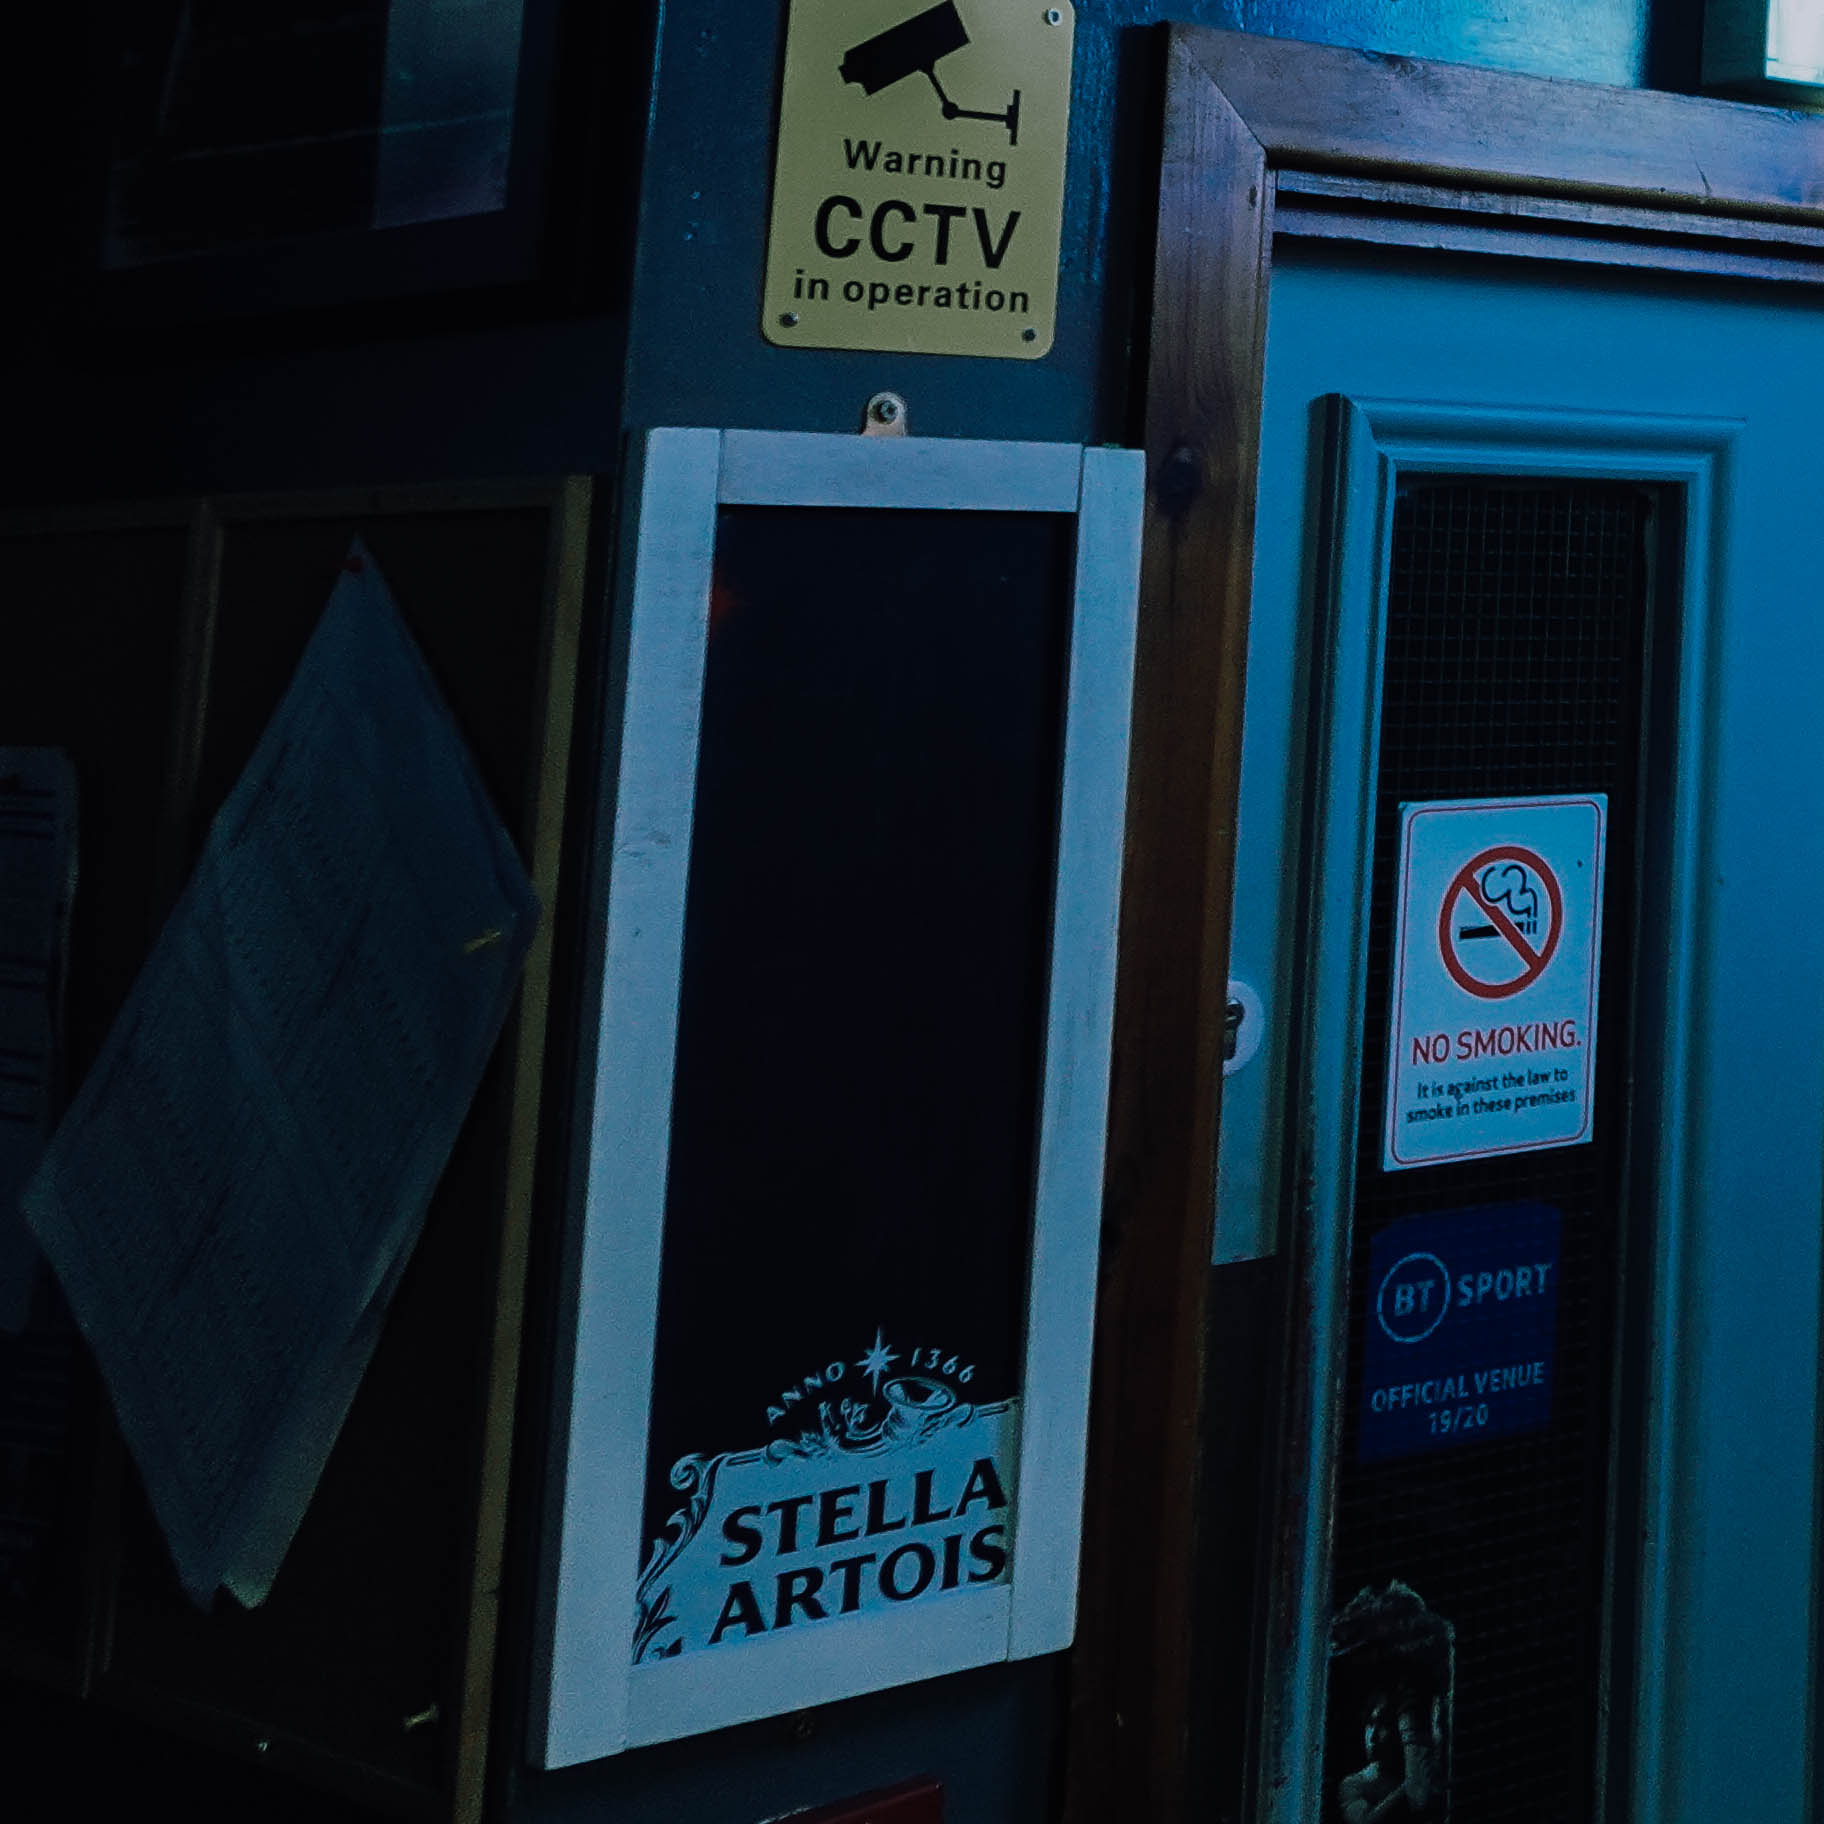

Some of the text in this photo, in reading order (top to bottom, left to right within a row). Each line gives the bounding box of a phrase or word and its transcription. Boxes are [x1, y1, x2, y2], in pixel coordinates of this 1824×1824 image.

[844, 139, 1006, 189] Warning
[814, 194, 1021, 269] CCTV
[793, 269, 1029, 314] in operation
[1412, 1019, 1582, 1066] NO SMOKING.
[1407, 1088, 1577, 1124] smoke in these premises
[1417, 1068, 1568, 1103] It is against the law to
[1393, 1262, 1552, 1317] BT SPORT
[766, 1347, 977, 1425] ANNO 1366
[1371, 1361, 1545, 1412] OFFICIAL VENUE
[1428, 1403, 1489, 1436] 19/20
[719, 1456, 1007, 1567] STELLA
[707, 1525, 1007, 1645] ARTOIS
